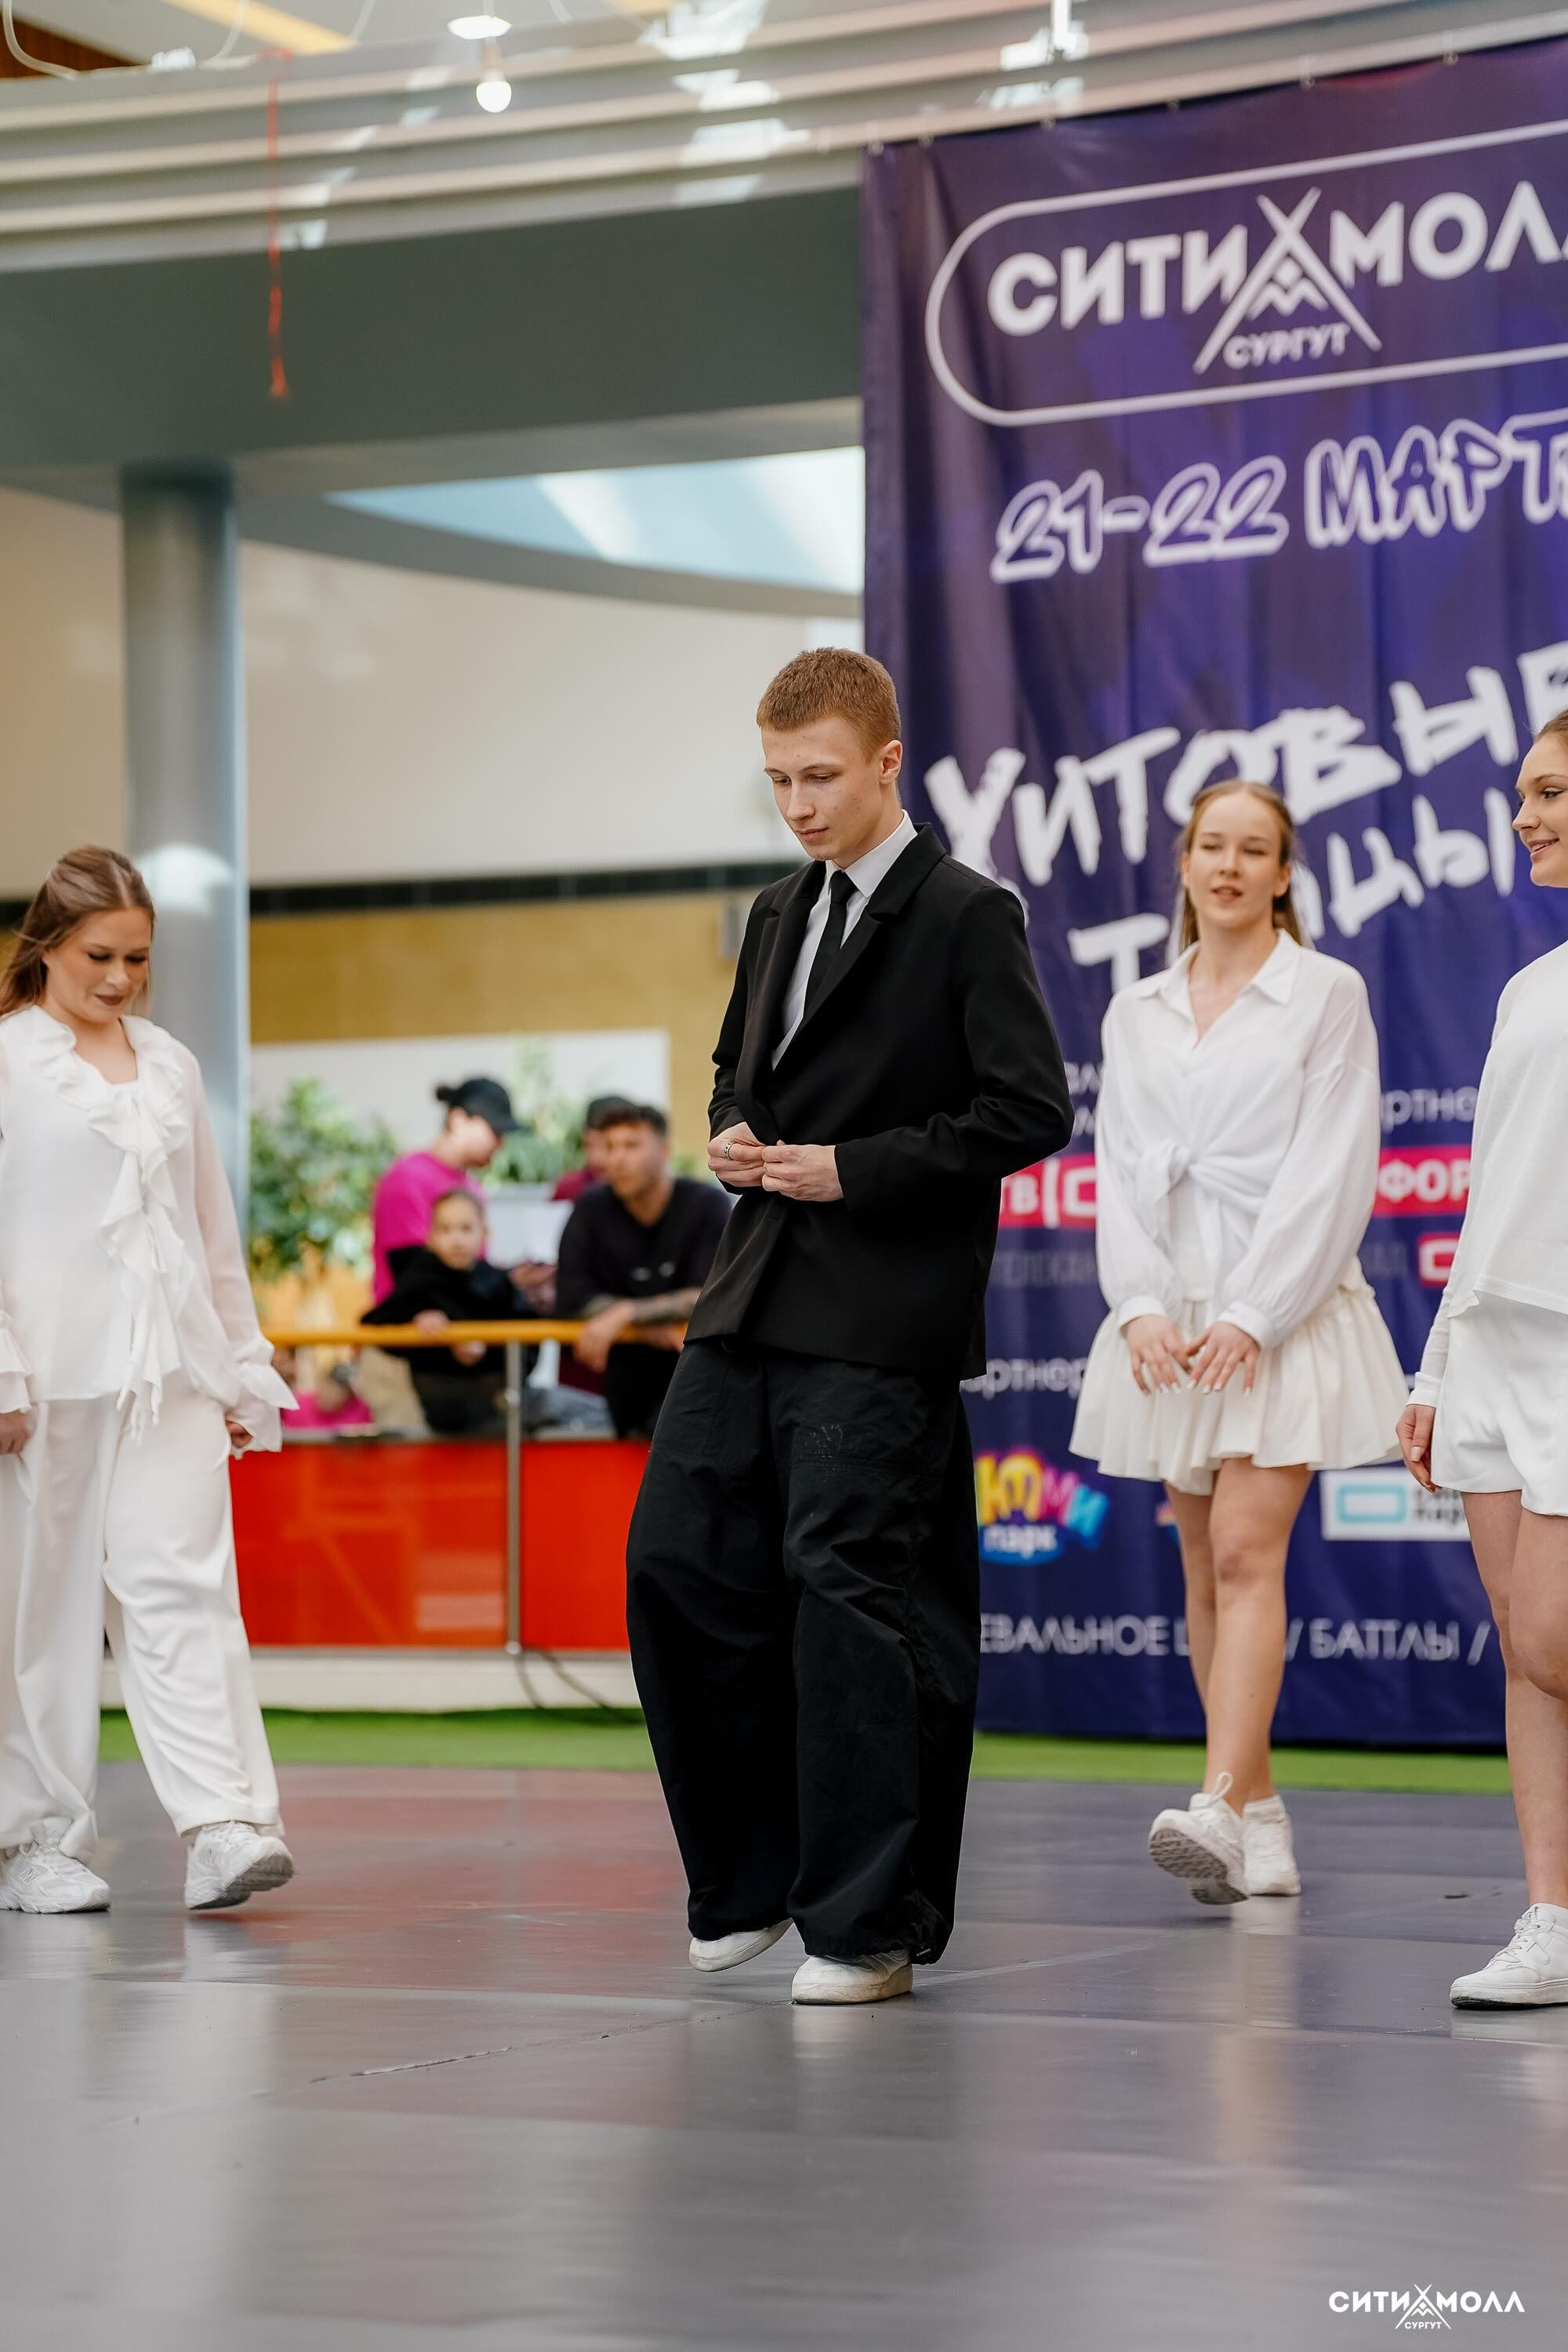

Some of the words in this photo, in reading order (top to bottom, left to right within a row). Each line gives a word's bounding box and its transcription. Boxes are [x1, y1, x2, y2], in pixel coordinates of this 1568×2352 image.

[1330, 180, 1568, 289] МОЛ
[1223, 323, 1352, 370] СУРГУТ
[990, 455, 1290, 584] 21-22
[1305, 406, 1568, 549] МАРТ
[1309, 1617, 1460, 1661] БАТТЛЫ
